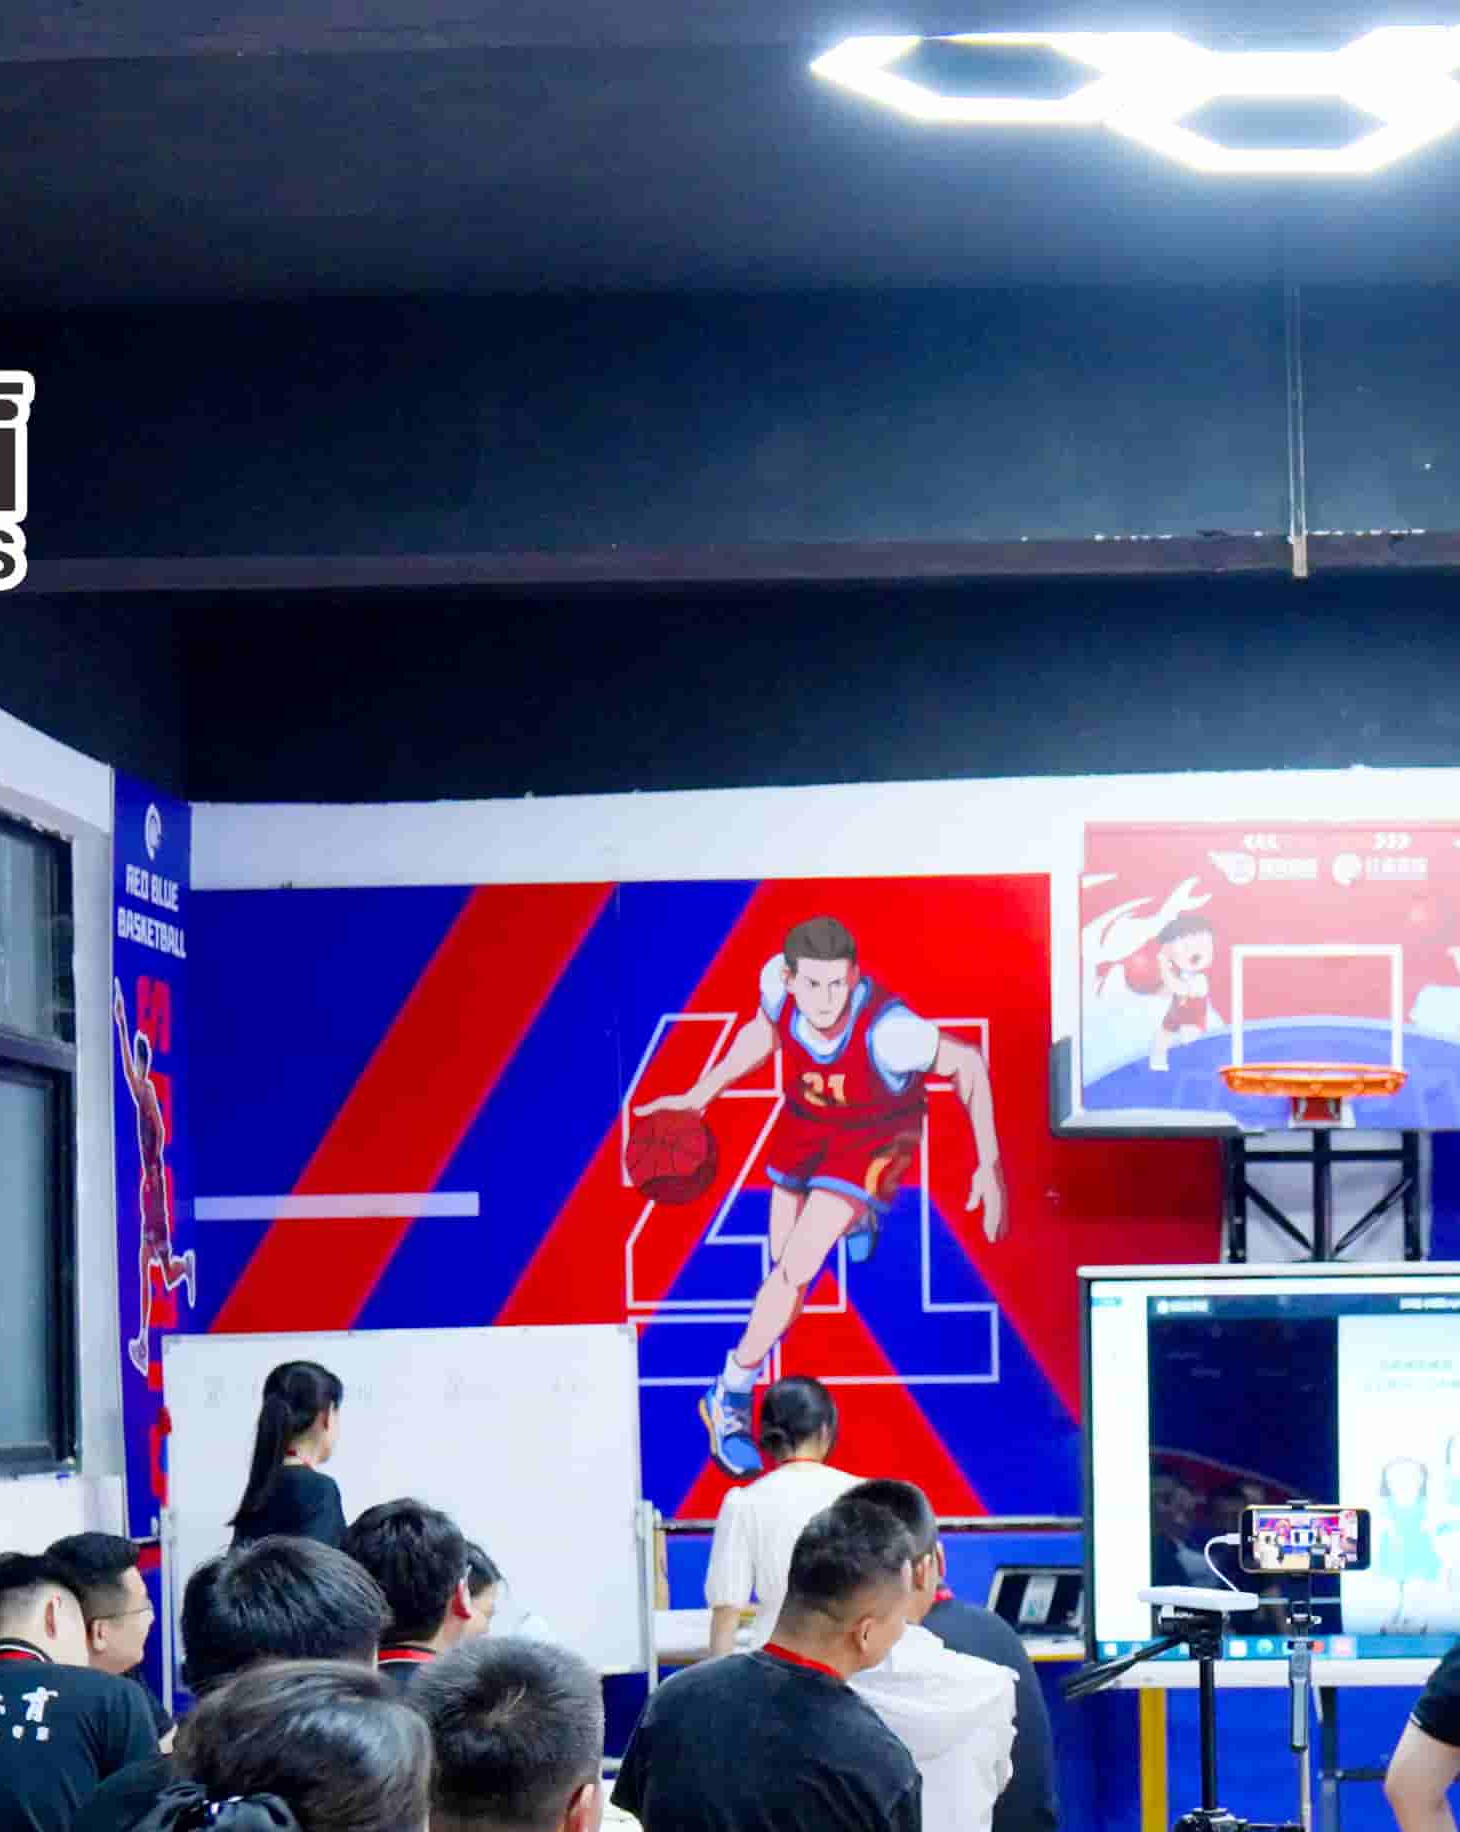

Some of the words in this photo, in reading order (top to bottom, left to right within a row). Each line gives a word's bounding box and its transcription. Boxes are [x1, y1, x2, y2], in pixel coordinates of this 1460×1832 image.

[125, 864, 150, 901] RED
[151, 872, 180, 913] BLUE
[117, 907, 187, 959] BASKETBALL
